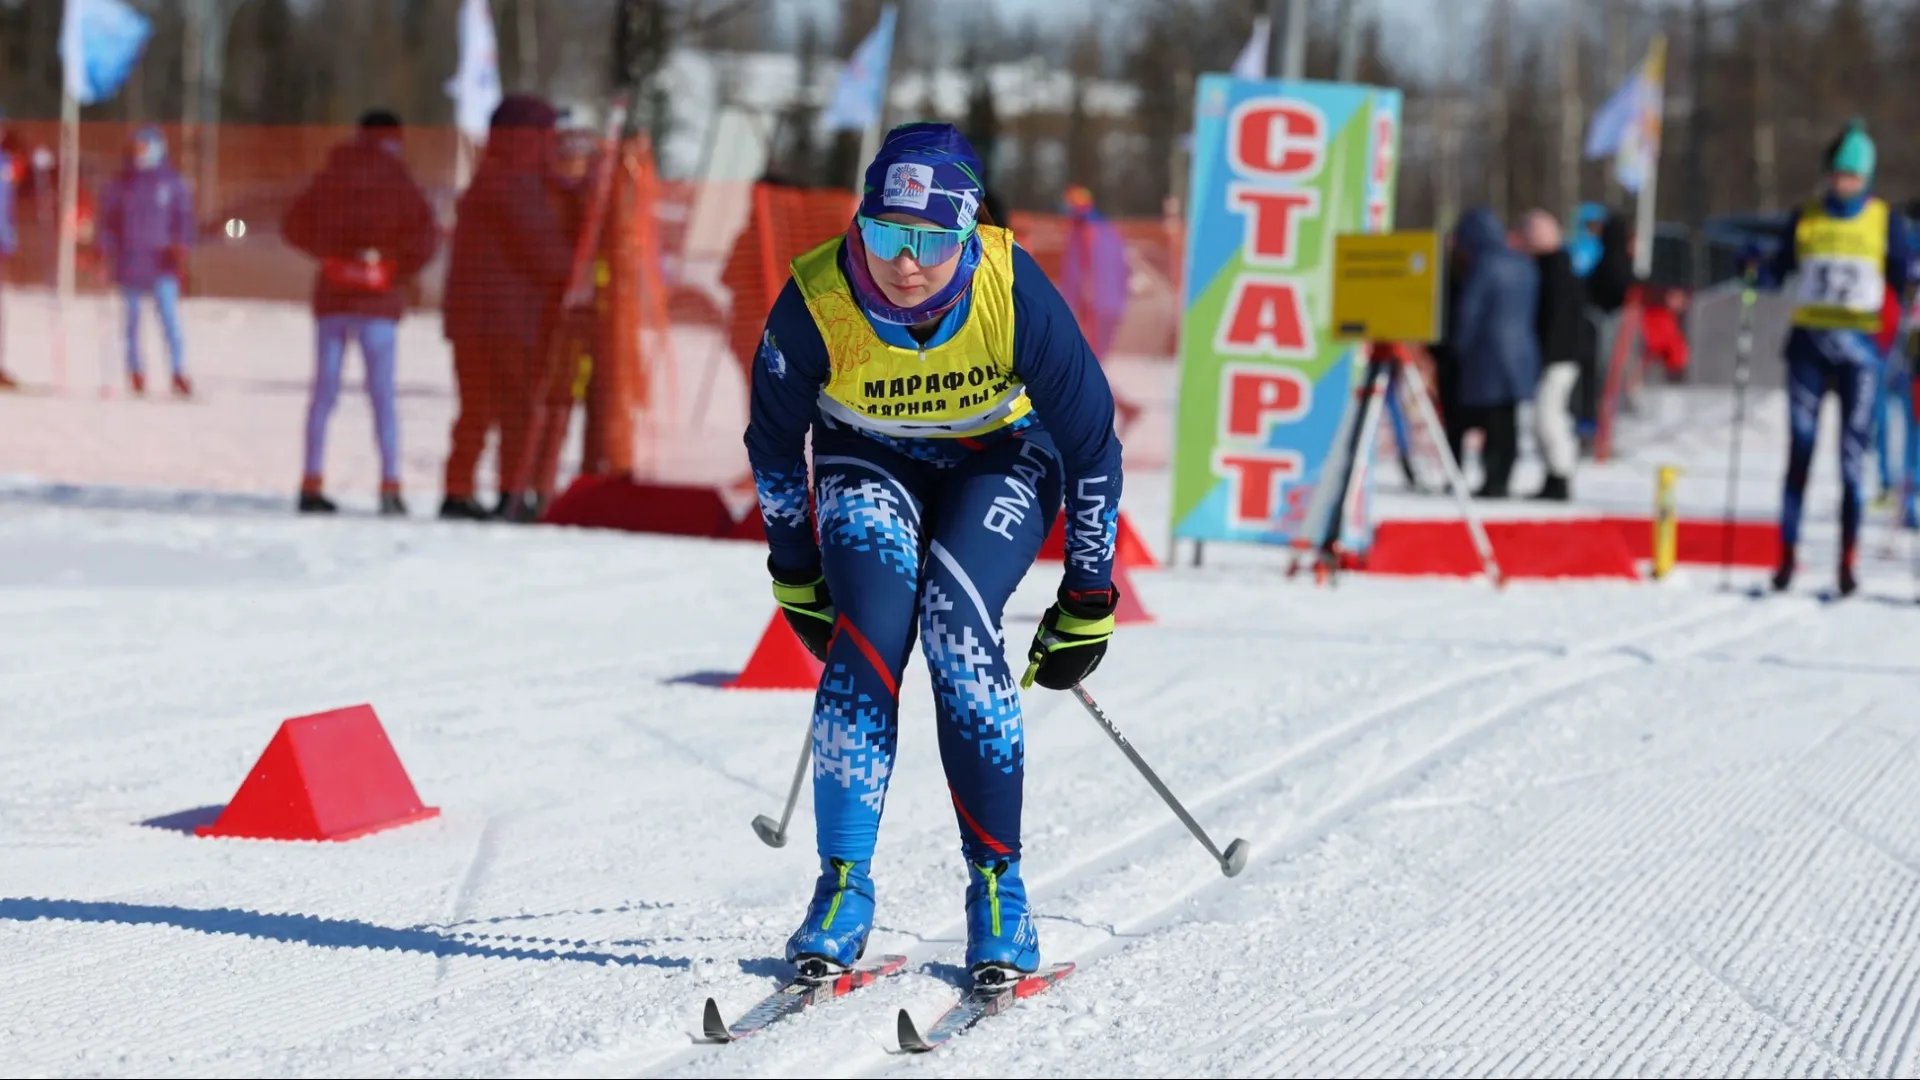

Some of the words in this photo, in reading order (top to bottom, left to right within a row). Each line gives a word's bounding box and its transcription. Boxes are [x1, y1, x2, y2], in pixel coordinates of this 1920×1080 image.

[1214, 98, 1328, 530] СТАРТ
[845, 399, 946, 417] ЛЯРНАЯ
[864, 363, 1001, 399] МАРАФОН
[983, 440, 1054, 542] ЯМАЛ
